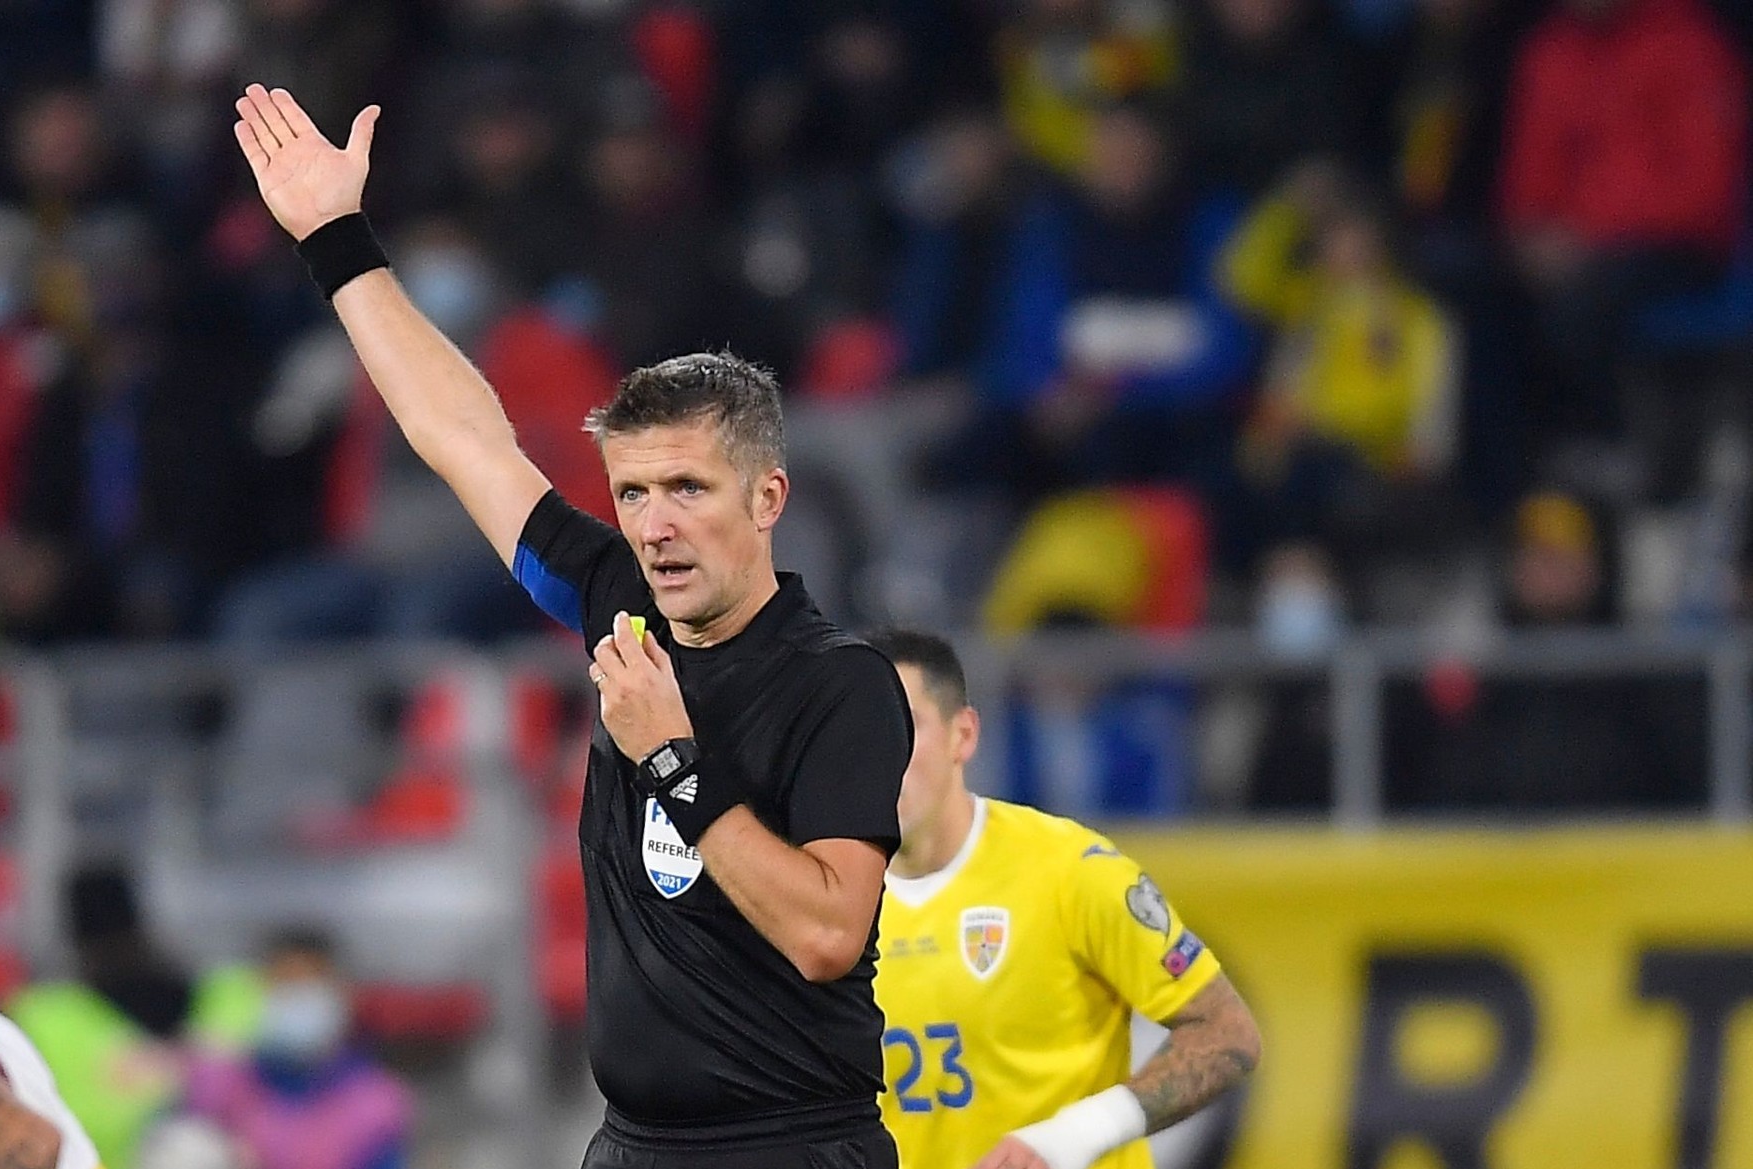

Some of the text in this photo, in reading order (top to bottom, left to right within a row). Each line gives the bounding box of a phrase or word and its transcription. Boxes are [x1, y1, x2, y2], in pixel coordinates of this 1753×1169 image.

[647, 840, 699, 861] REFEREE
[657, 874, 682, 890] 2021
[883, 1023, 973, 1113] 23
